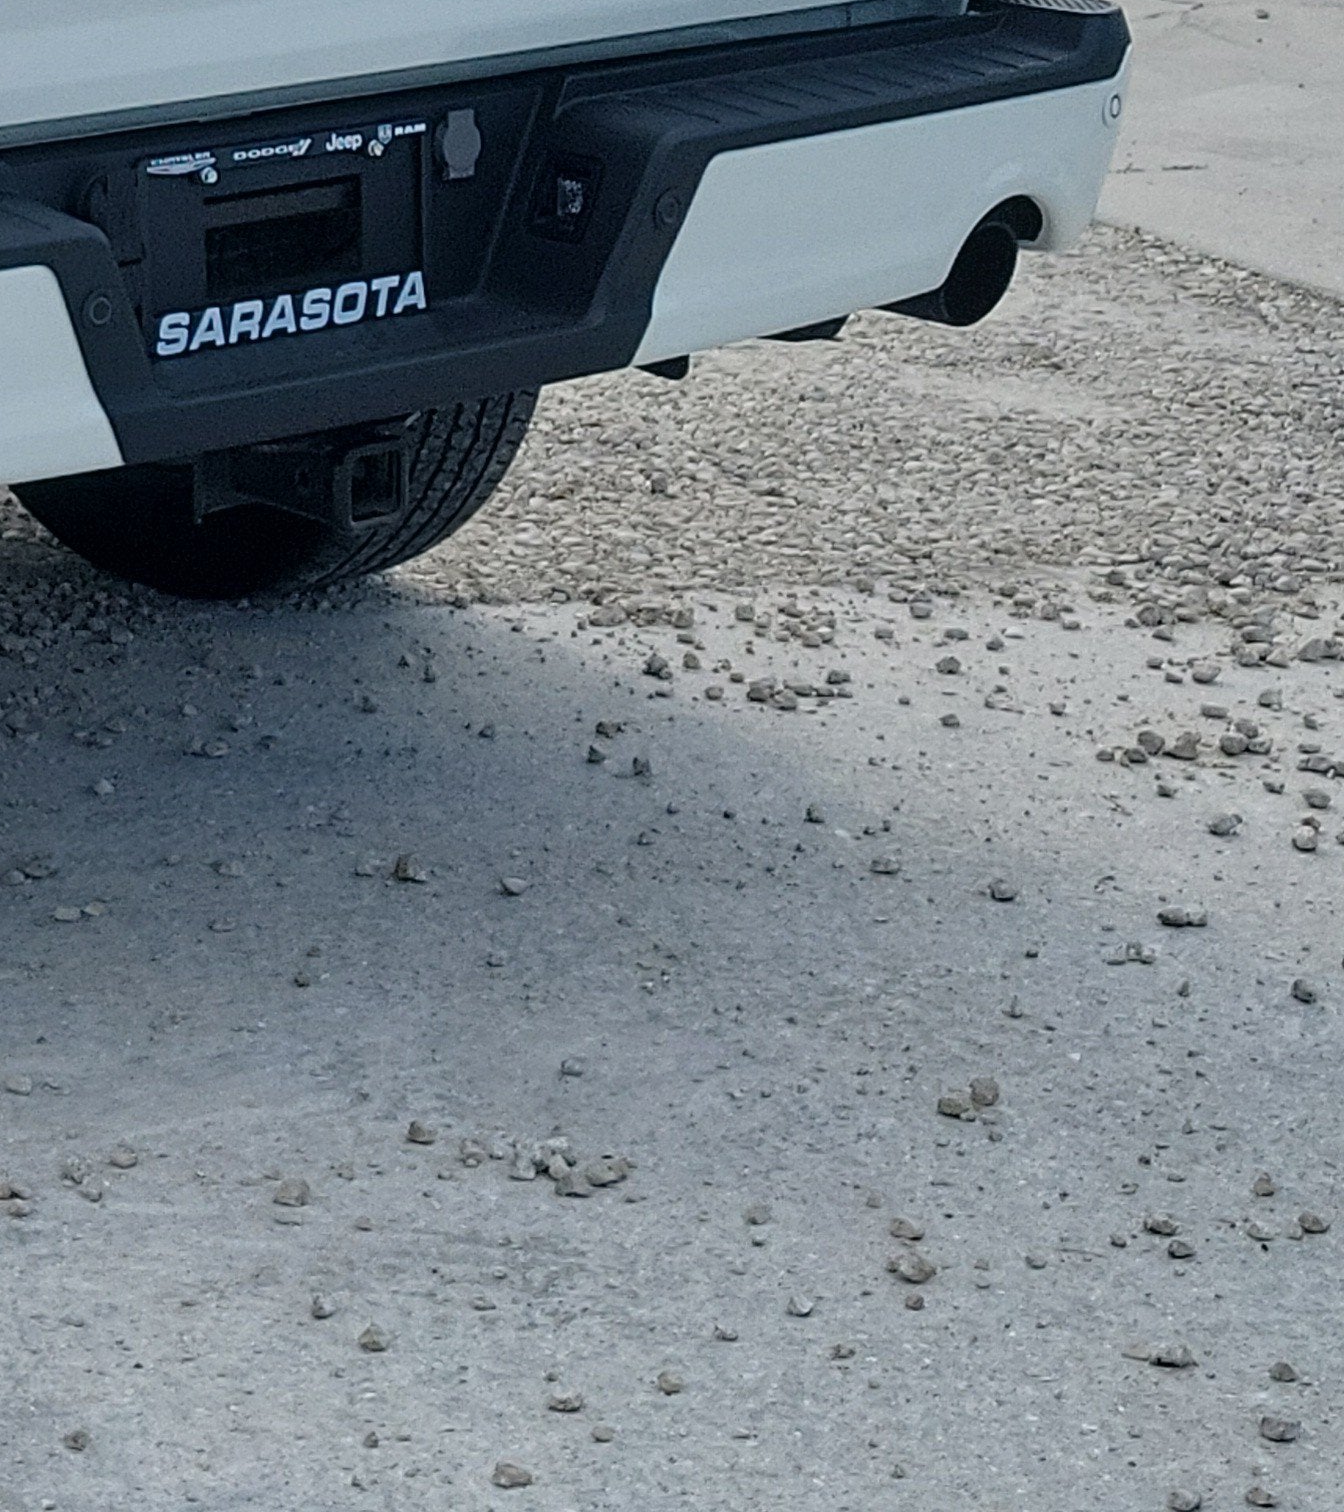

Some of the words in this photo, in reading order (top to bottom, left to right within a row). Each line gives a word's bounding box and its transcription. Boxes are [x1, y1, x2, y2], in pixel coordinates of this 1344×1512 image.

[325, 133, 363, 152] Jeep
[394, 122, 427, 137] RAM
[156, 270, 427, 357] SARASOTA
